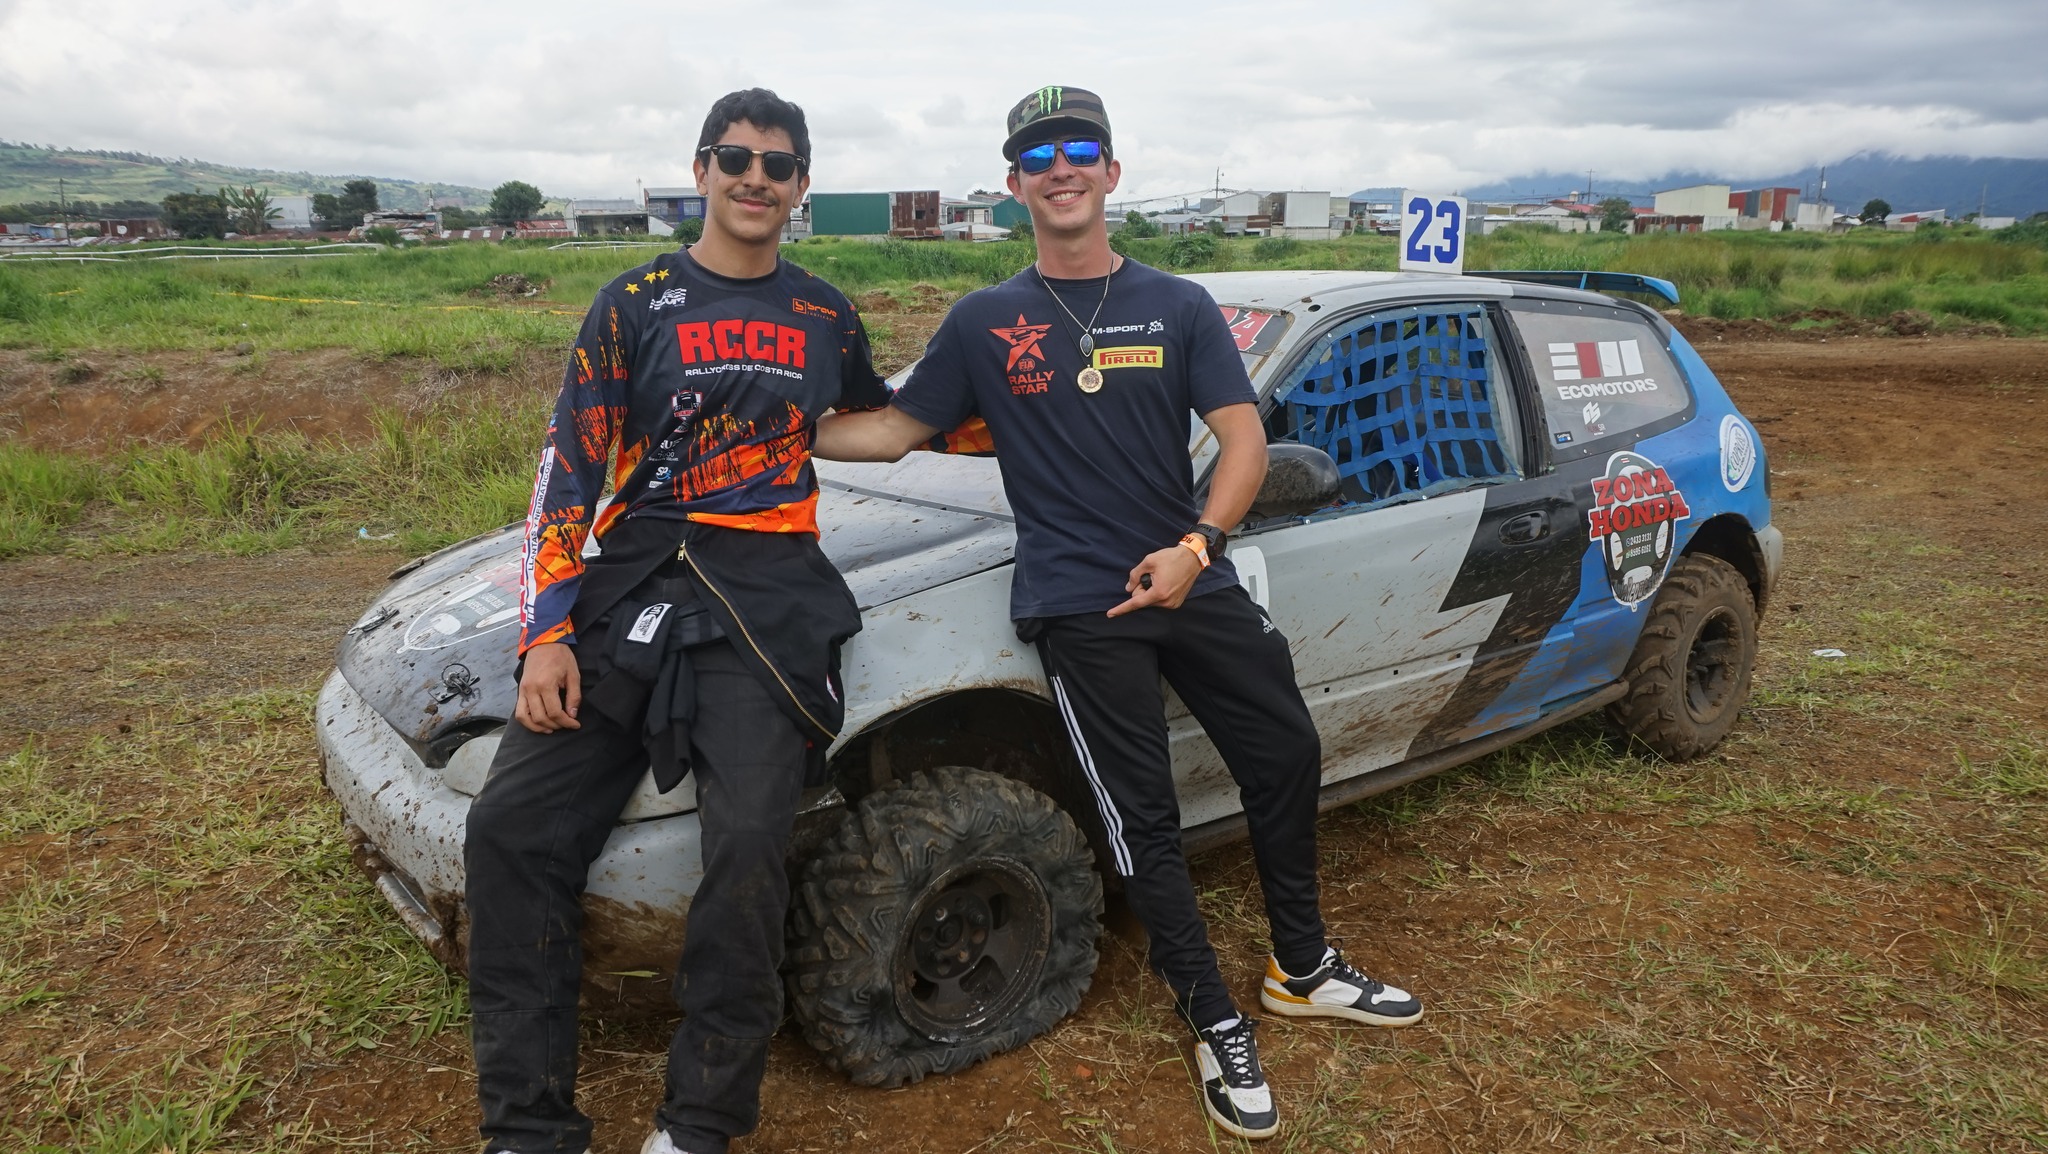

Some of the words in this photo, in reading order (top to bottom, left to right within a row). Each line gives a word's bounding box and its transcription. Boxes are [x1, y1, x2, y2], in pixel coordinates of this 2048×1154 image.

[1407, 197, 1460, 264] 23
[1092, 325, 1145, 335] M-SPORT
[676, 319, 806, 369] RCCR
[1018, 360, 1035, 371] FIA
[1099, 350, 1158, 366] PIRELLI
[685, 363, 740, 377] RALLYCROSS
[741, 364, 754, 372] DE
[754, 364, 783, 376] COSTA
[783, 370, 803, 380] RICA
[1008, 370, 1055, 385] RALLY
[1011, 382, 1048, 395] STAR
[1557, 378, 1658, 401] ECOMOTORS
[1593, 468, 1674, 507] ZONA
[1590, 493, 1690, 539] HONDA
[528, 530, 539, 571] LLANTAS
